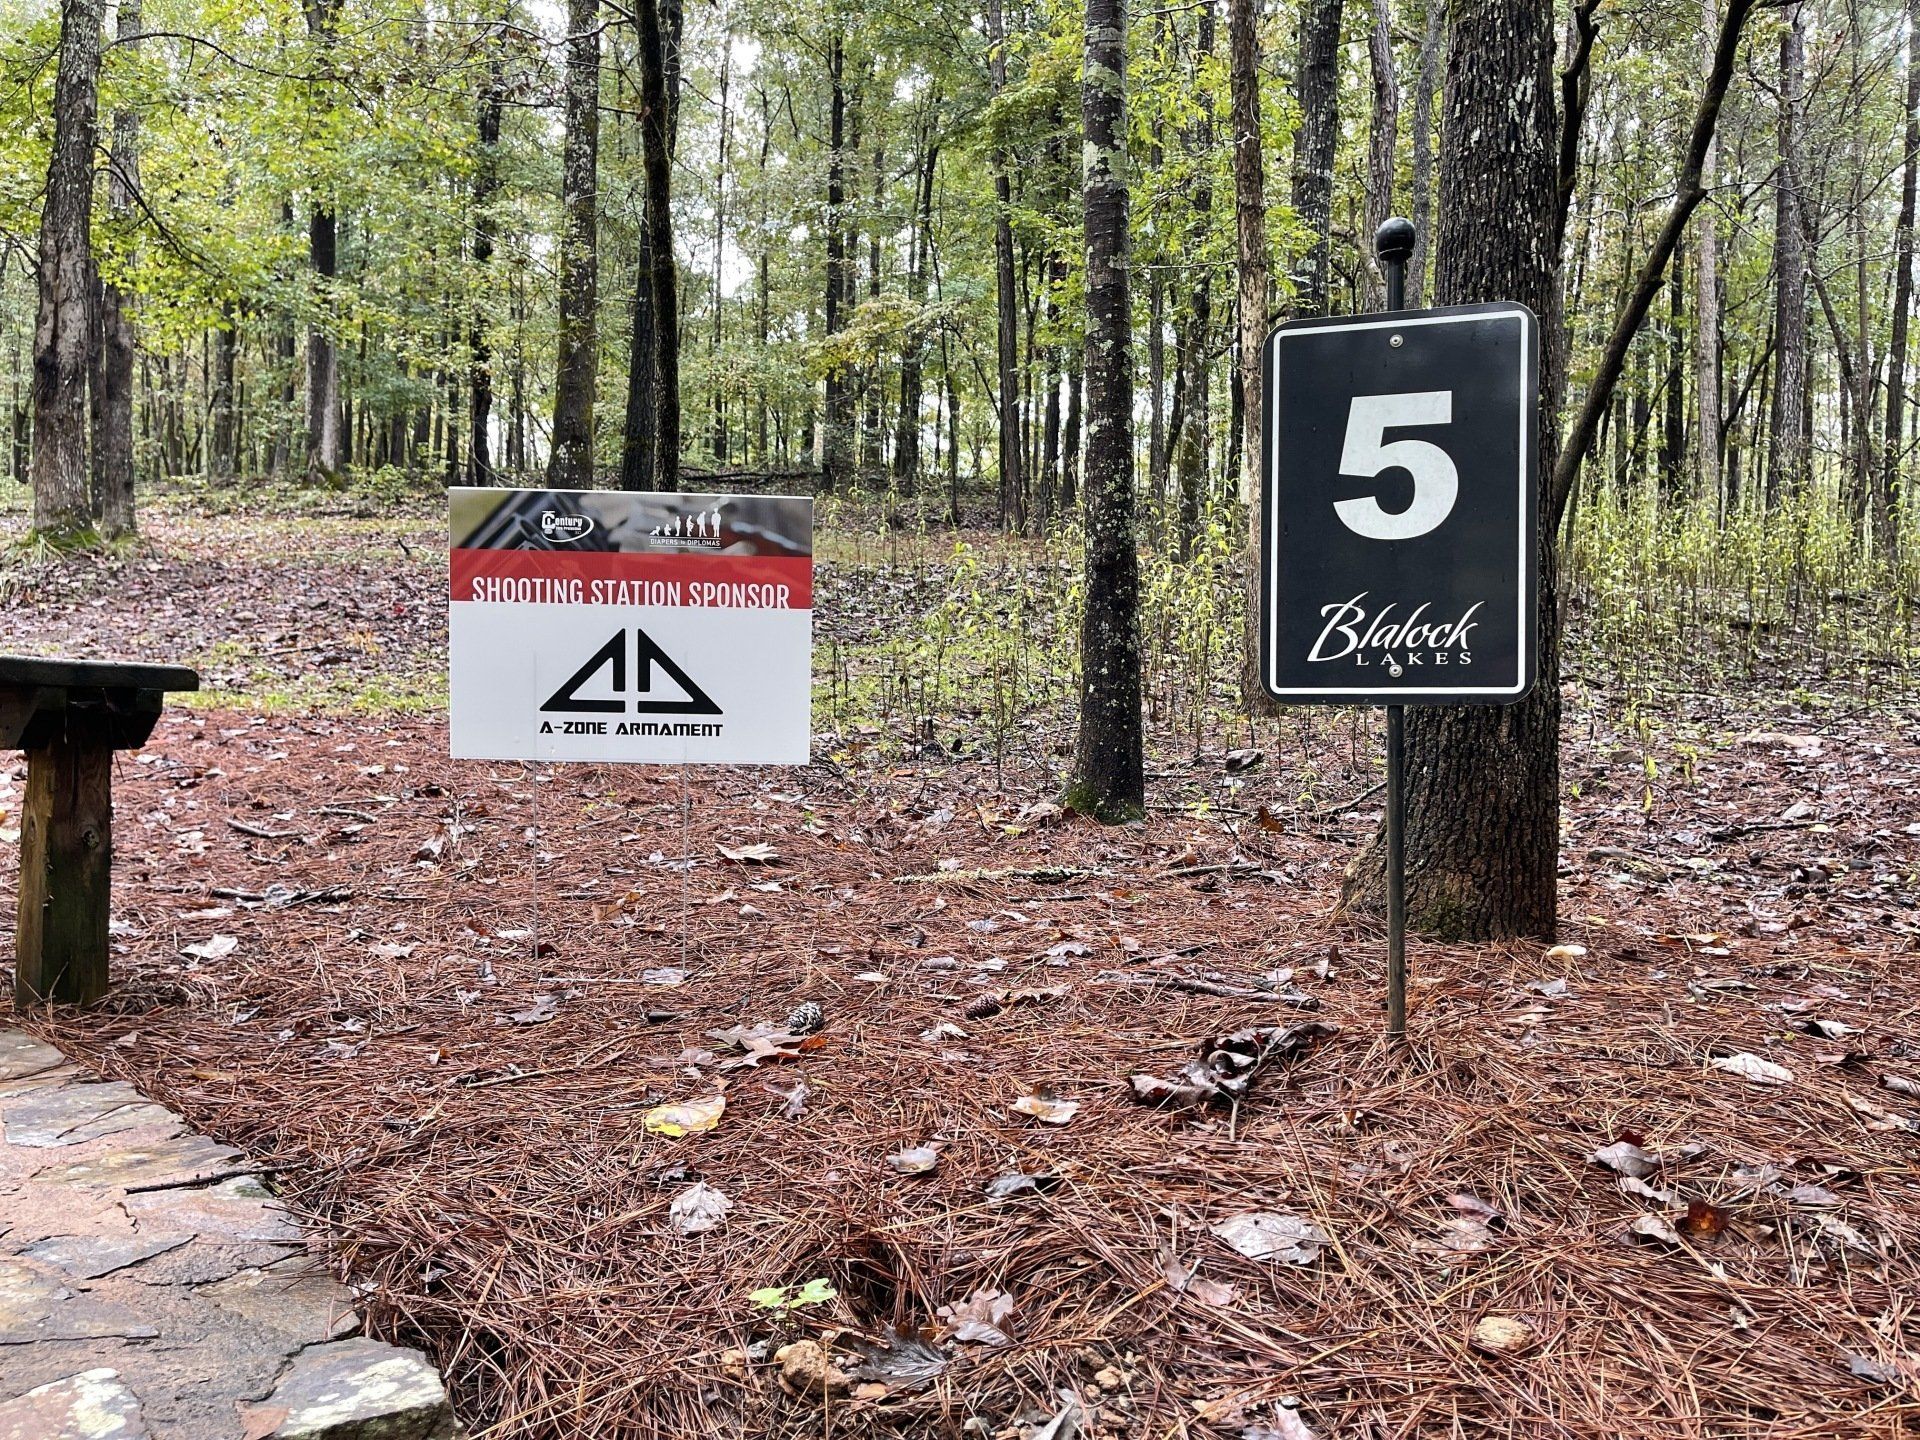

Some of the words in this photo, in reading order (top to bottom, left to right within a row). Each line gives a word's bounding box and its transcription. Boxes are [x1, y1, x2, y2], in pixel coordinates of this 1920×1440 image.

[1333, 390, 1459, 540] 5
[541, 512, 583, 530] Century
[650, 538, 678, 546] DIAPERS
[687, 539, 721, 547] DIPLOMAS
[472, 576, 583, 604] SHOOTING
[590, 579, 682, 607] STATION
[688, 582, 790, 610] SPONSOR
[1307, 591, 1485, 662] Blalock
[1356, 651, 1472, 666] LAKES
[539, 721, 608, 735] A-ZONE
[615, 722, 724, 737] ARMAMENT
